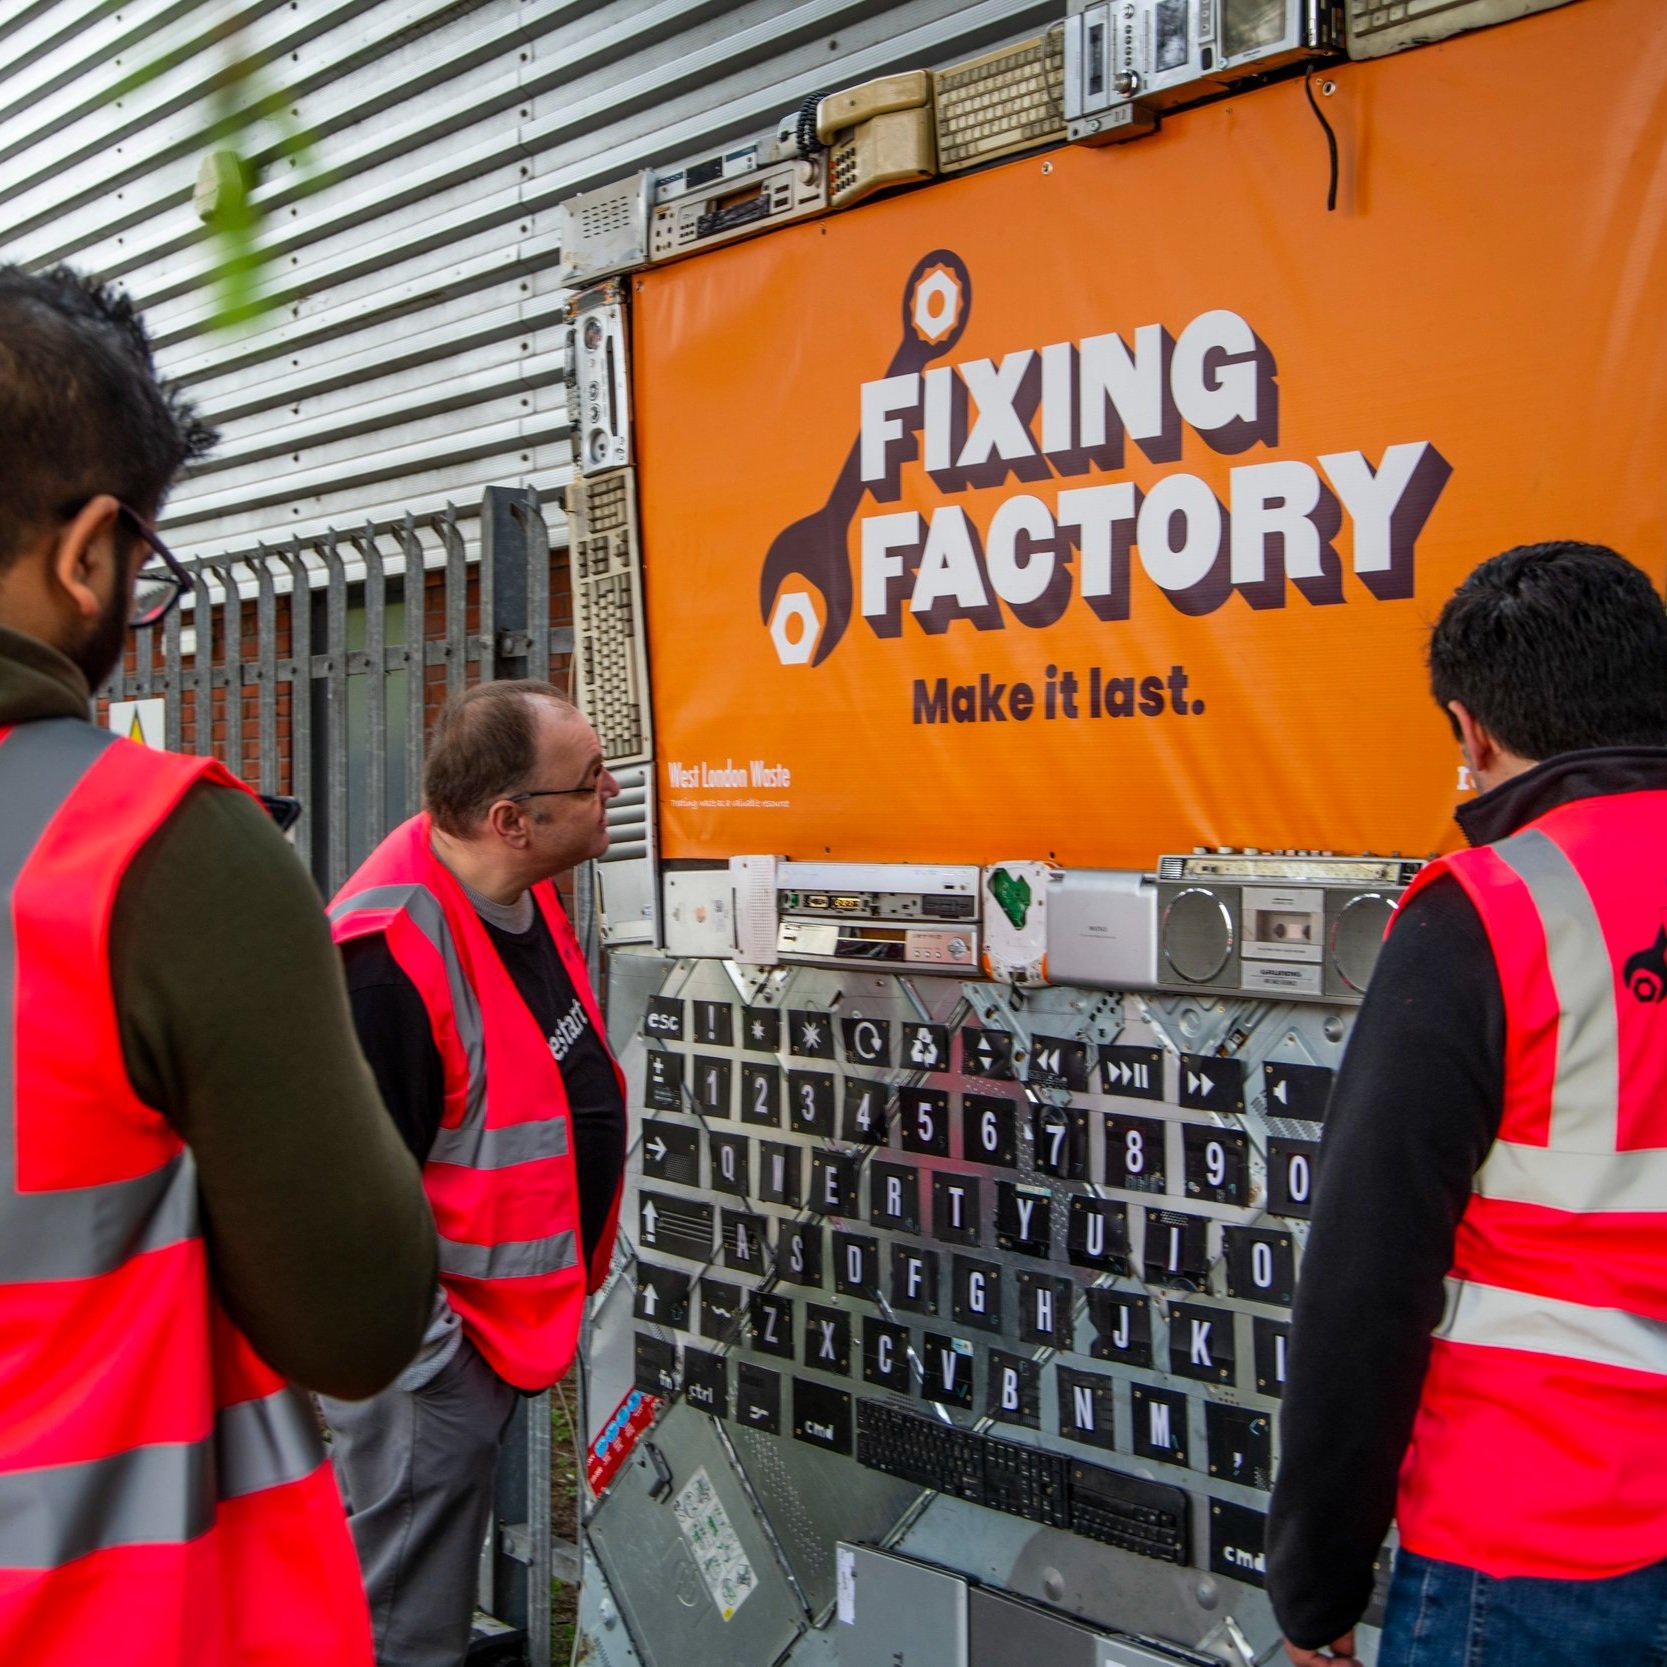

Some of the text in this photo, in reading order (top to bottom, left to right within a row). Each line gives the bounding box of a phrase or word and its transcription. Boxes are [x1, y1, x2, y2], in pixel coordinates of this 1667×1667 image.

[861, 310, 1258, 482] FIXING
[861, 441, 1430, 618] FACTORY
[913, 664, 1206, 725] Make it last.
[668, 758, 791, 789] West London Waste
[648, 1011, 679, 1031] esc
[706, 1069, 717, 1106] 1
[754, 1076, 768, 1114] 2
[800, 1084, 815, 1121] 3
[856, 1093, 871, 1131] 4
[918, 1102, 933, 1141] 5
[981, 1110, 997, 1151] 6
[1045, 1124, 1066, 1166] 7
[1125, 1129, 1144, 1173] 8
[1206, 1141, 1225, 1186] 9
[721, 1145, 735, 1182] Q
[824, 1165, 839, 1204] E
[886, 1176, 902, 1217] R
[948, 1186, 964, 1227] T
[1016, 1199, 1034, 1241] Y
[1086, 1212, 1104, 1256] U
[1168, 1227, 1179, 1272] I
[736, 1223, 751, 1260] A
[790, 1235, 804, 1273] S
[847, 1244, 862, 1284] D
[908, 1258, 923, 1297] F
[969, 1271, 985, 1313] G
[1037, 1288, 1052, 1332] H
[1113, 1305, 1129, 1349] J
[1190, 1319, 1212, 1367] K
[763, 1305, 779, 1344] Z
[819, 1322, 836, 1360] X
[878, 1334, 893, 1373] C
[941, 1349, 957, 1391] V
[1001, 1367, 1018, 1410] B
[1073, 1385, 1094, 1430] N
[1149, 1401, 1170, 1448] M
[687, 1383, 713, 1404] ctrl
[805, 1420, 834, 1441] cmd
[1223, 1546, 1267, 1573] cmd
